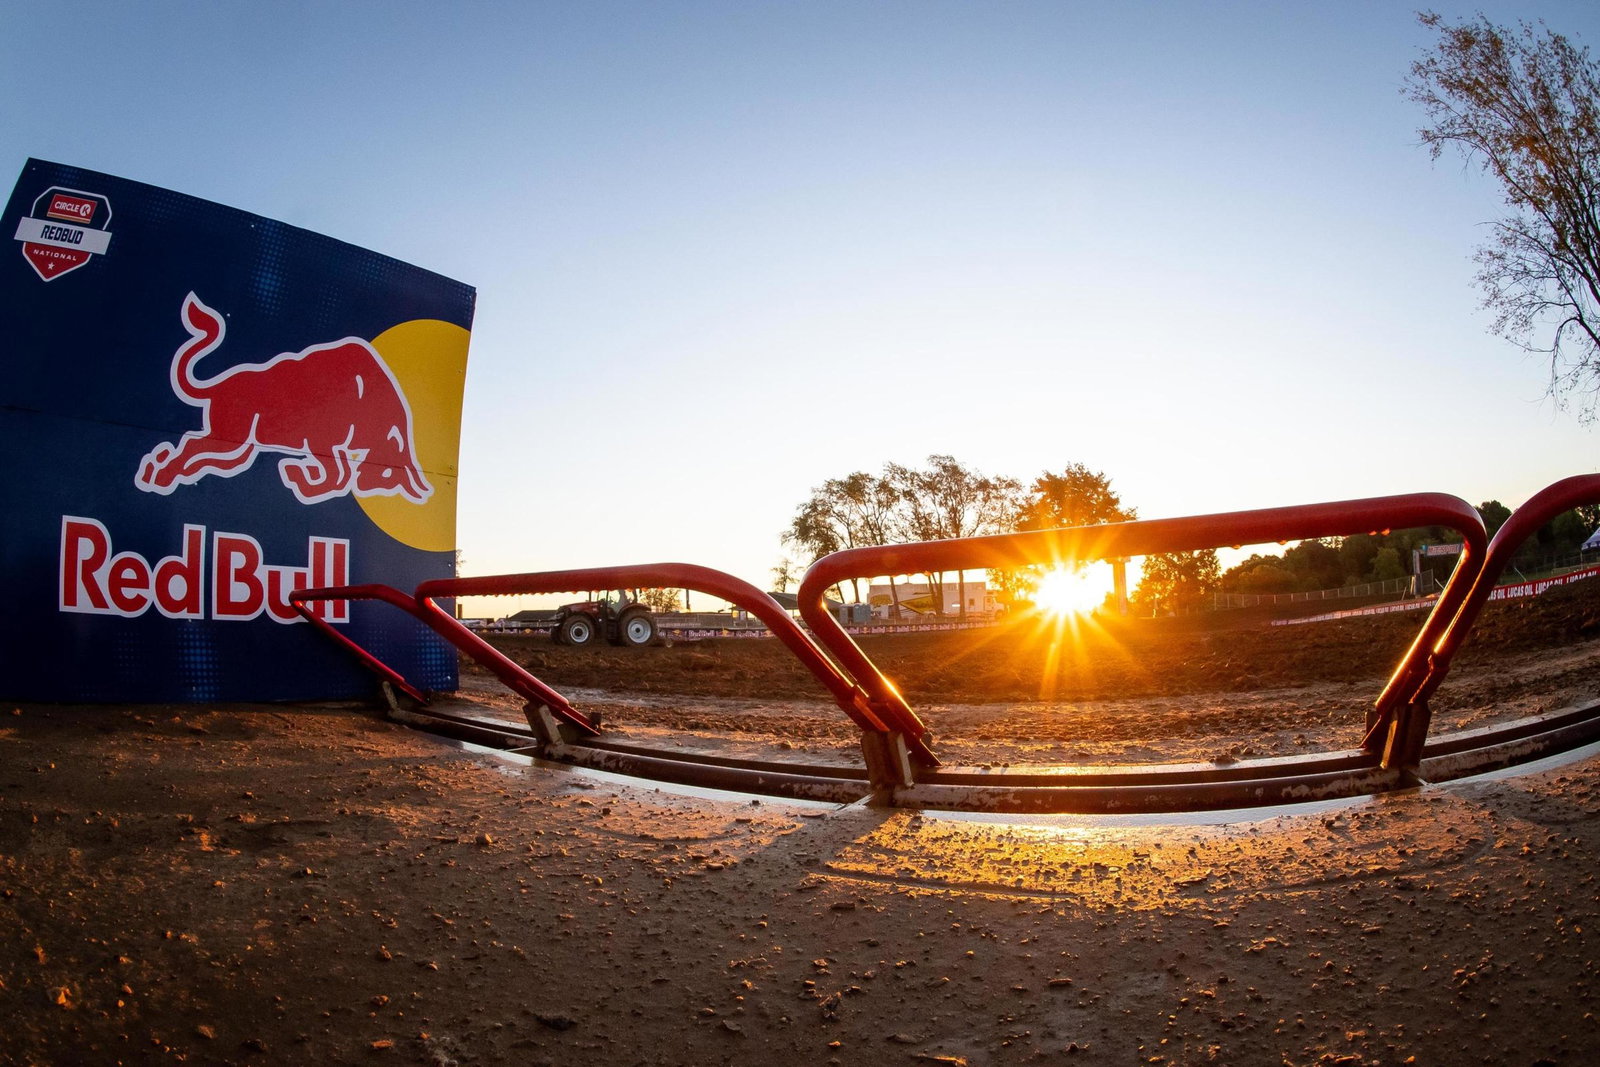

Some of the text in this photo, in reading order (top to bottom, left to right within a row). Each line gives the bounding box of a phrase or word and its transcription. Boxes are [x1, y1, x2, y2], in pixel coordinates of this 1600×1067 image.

[55, 201, 91, 216] CIRCLE K
[40, 225, 84, 244] REDBUD
[33, 249, 77, 261] NATIONAL
[60, 515, 350, 623] Red Bull
[1507, 585, 1524, 598] LUCAS
[1525, 584, 1533, 595] OIL
